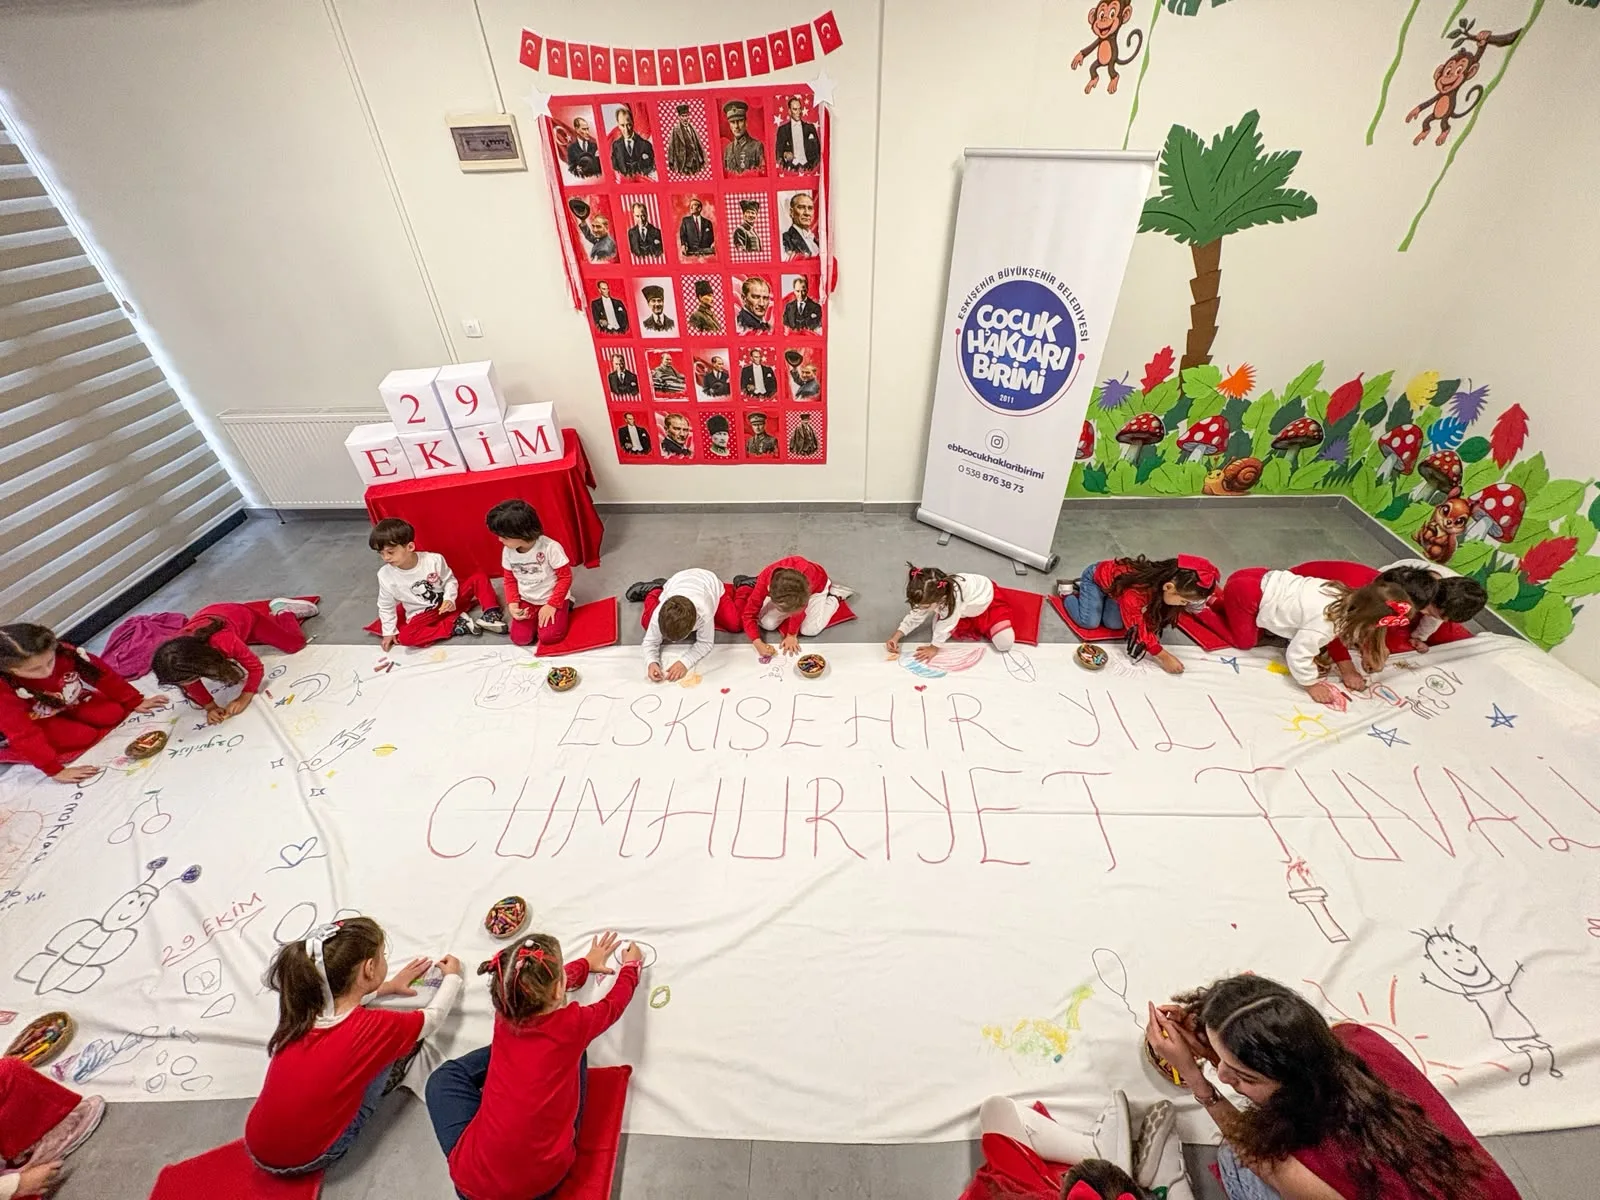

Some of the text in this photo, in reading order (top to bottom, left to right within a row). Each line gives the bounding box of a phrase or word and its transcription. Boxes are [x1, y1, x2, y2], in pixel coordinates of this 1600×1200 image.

[957, 265, 1090, 343] ESKİŞEHİR BÜYÜKŞEHİR BELEDİYESİ
[976, 304, 1063, 343] ÇOCUK
[967, 328, 1071, 371] HAKLARI
[399, 384, 479, 425] 29
[999, 394, 1015, 405] 2011
[363, 424, 555, 478] EKİM
[947, 442, 1045, 481] ebbcocukhaklaribirimi
[965, 467, 981, 480] 538
[982, 472, 999, 485] 876
[999, 477, 1012, 490] 38
[1012, 482, 1025, 494] 73
[167, 733, 245, 760] Özgürlük
[427, 763, 1117, 872] CUMHURİYET
[161, 891, 263, 967] 29 EKİM
